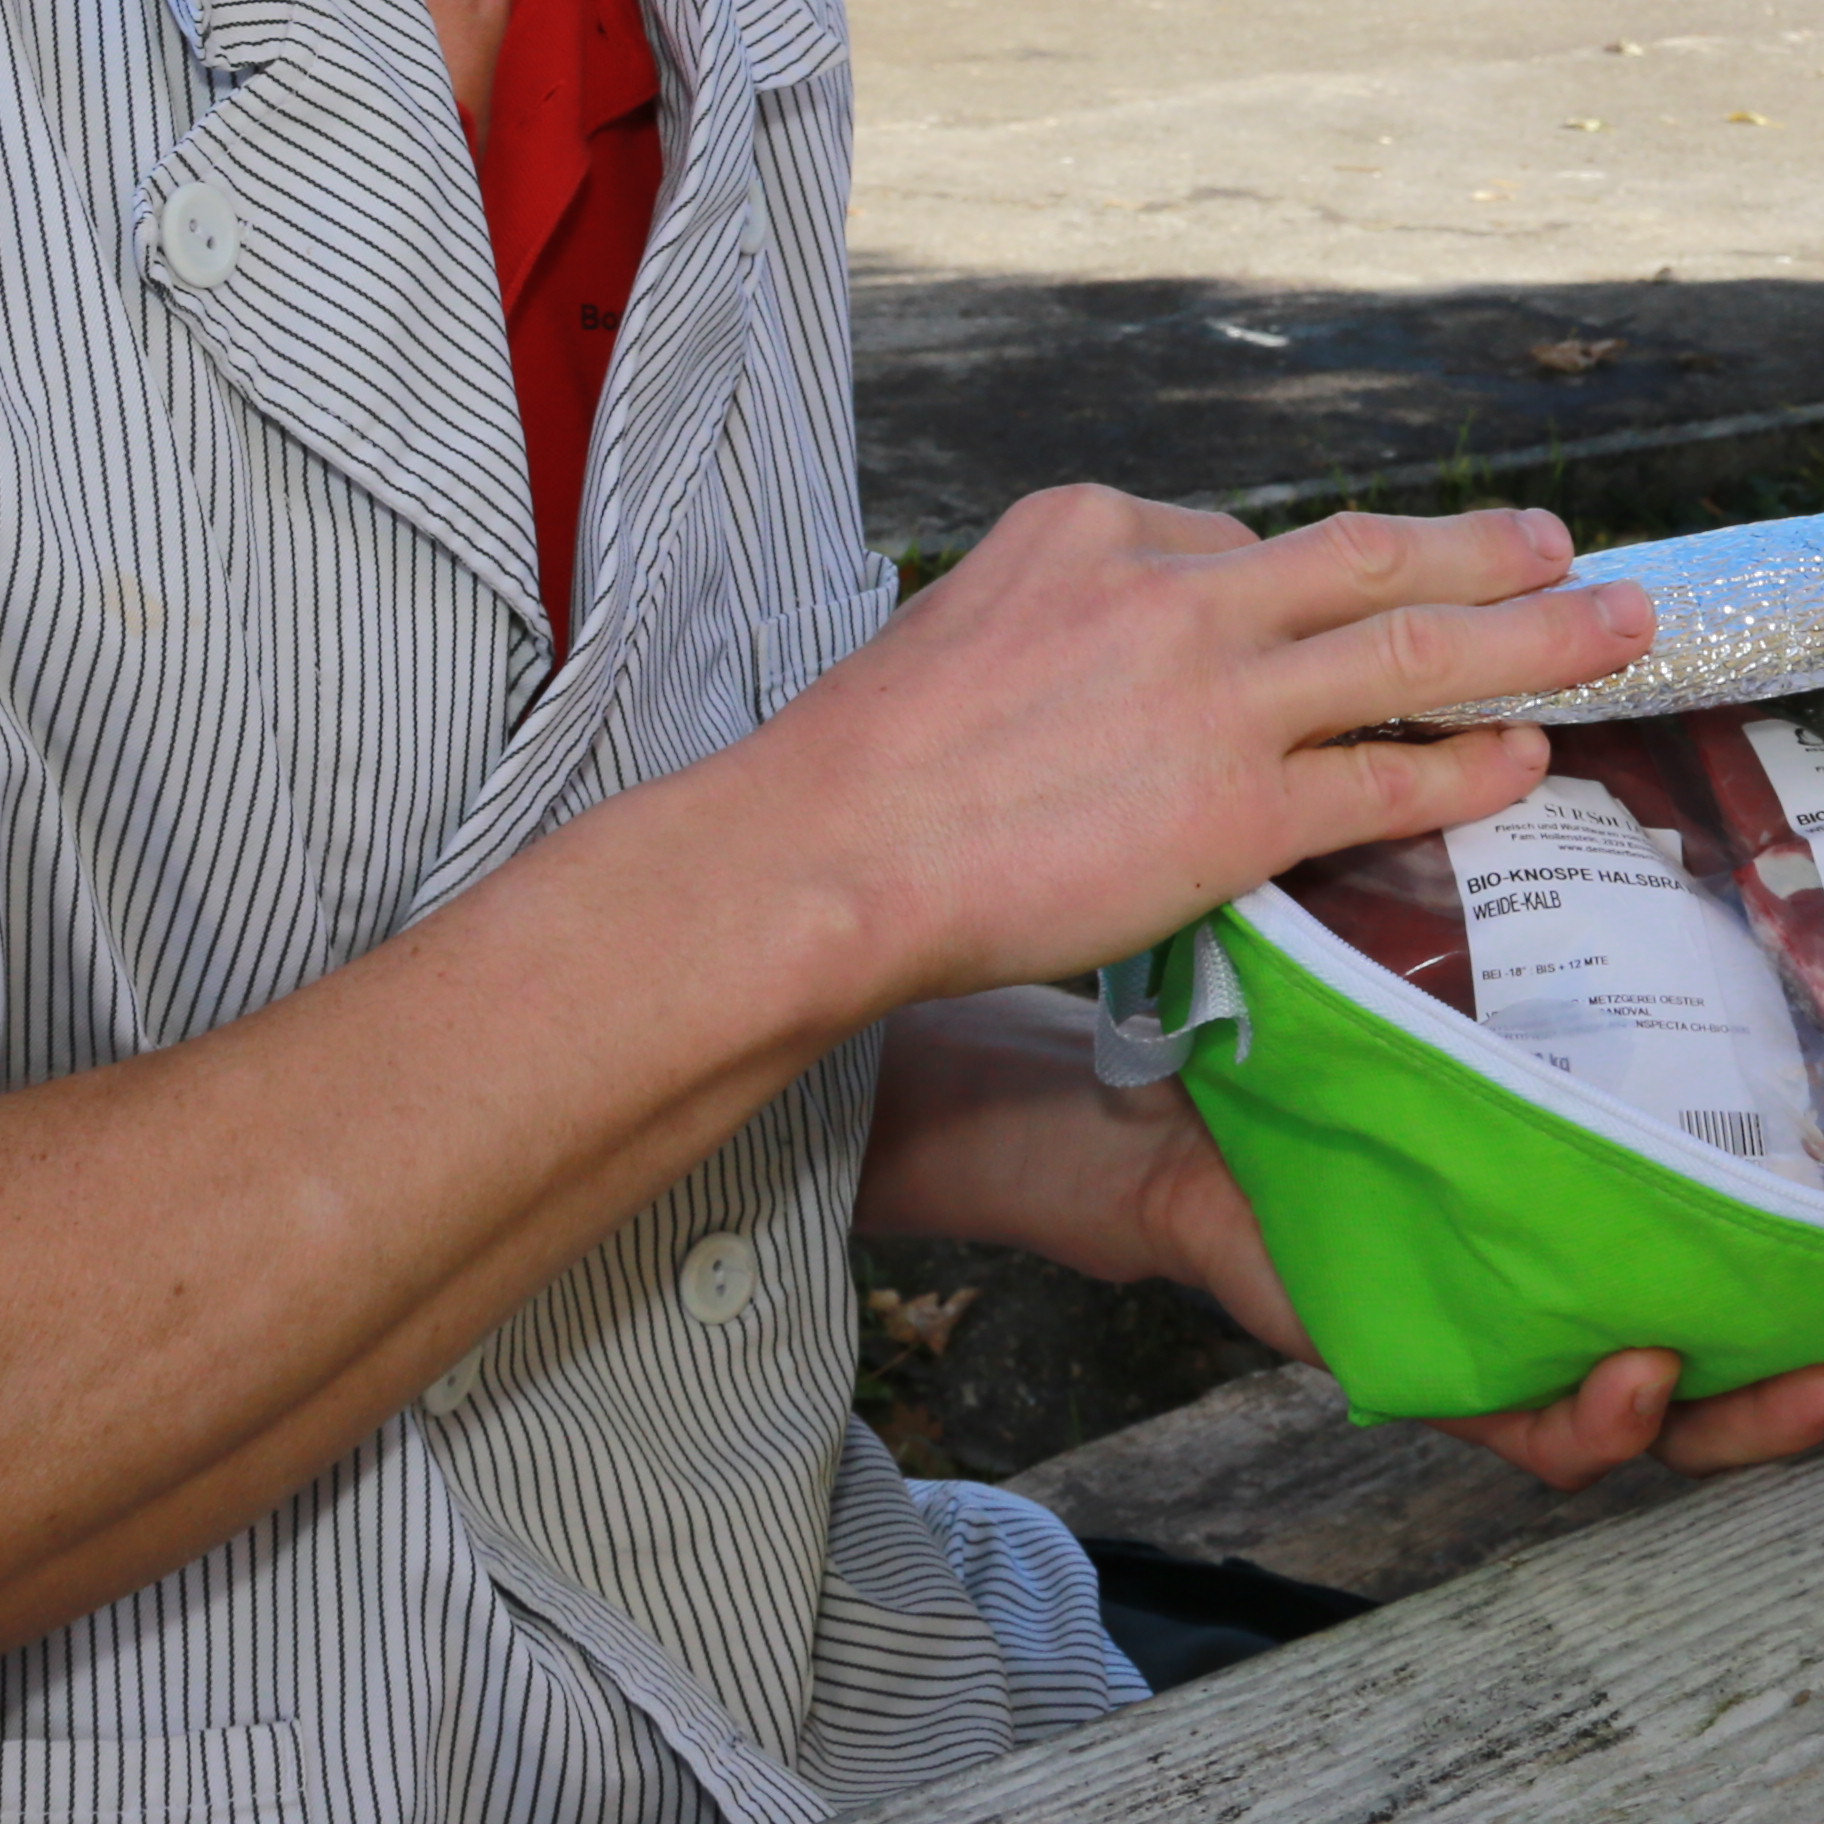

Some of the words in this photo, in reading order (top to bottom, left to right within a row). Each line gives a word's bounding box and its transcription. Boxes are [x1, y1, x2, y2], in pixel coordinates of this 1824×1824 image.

[581, 303, 624, 331] Bo
[1494, 822, 1535, 834] Fleisch
[1537, 822, 1559, 831] und
[1466, 866, 1594, 895] BIO-KNOSPE
[1472, 889, 1562, 921] WEIDE-KALB
[1482, 968, 1502, 981] BEI
[1536, 963, 1556, 975] BIS
[1568, 959, 1582, 970] 12
[1583, 955, 1609, 967] MTE
[1588, 994, 1657, 1006] METZGEREI
[1659, 995, 1705, 1007] OESTER
[1600, 1007, 1653, 1017] ANDVAL
